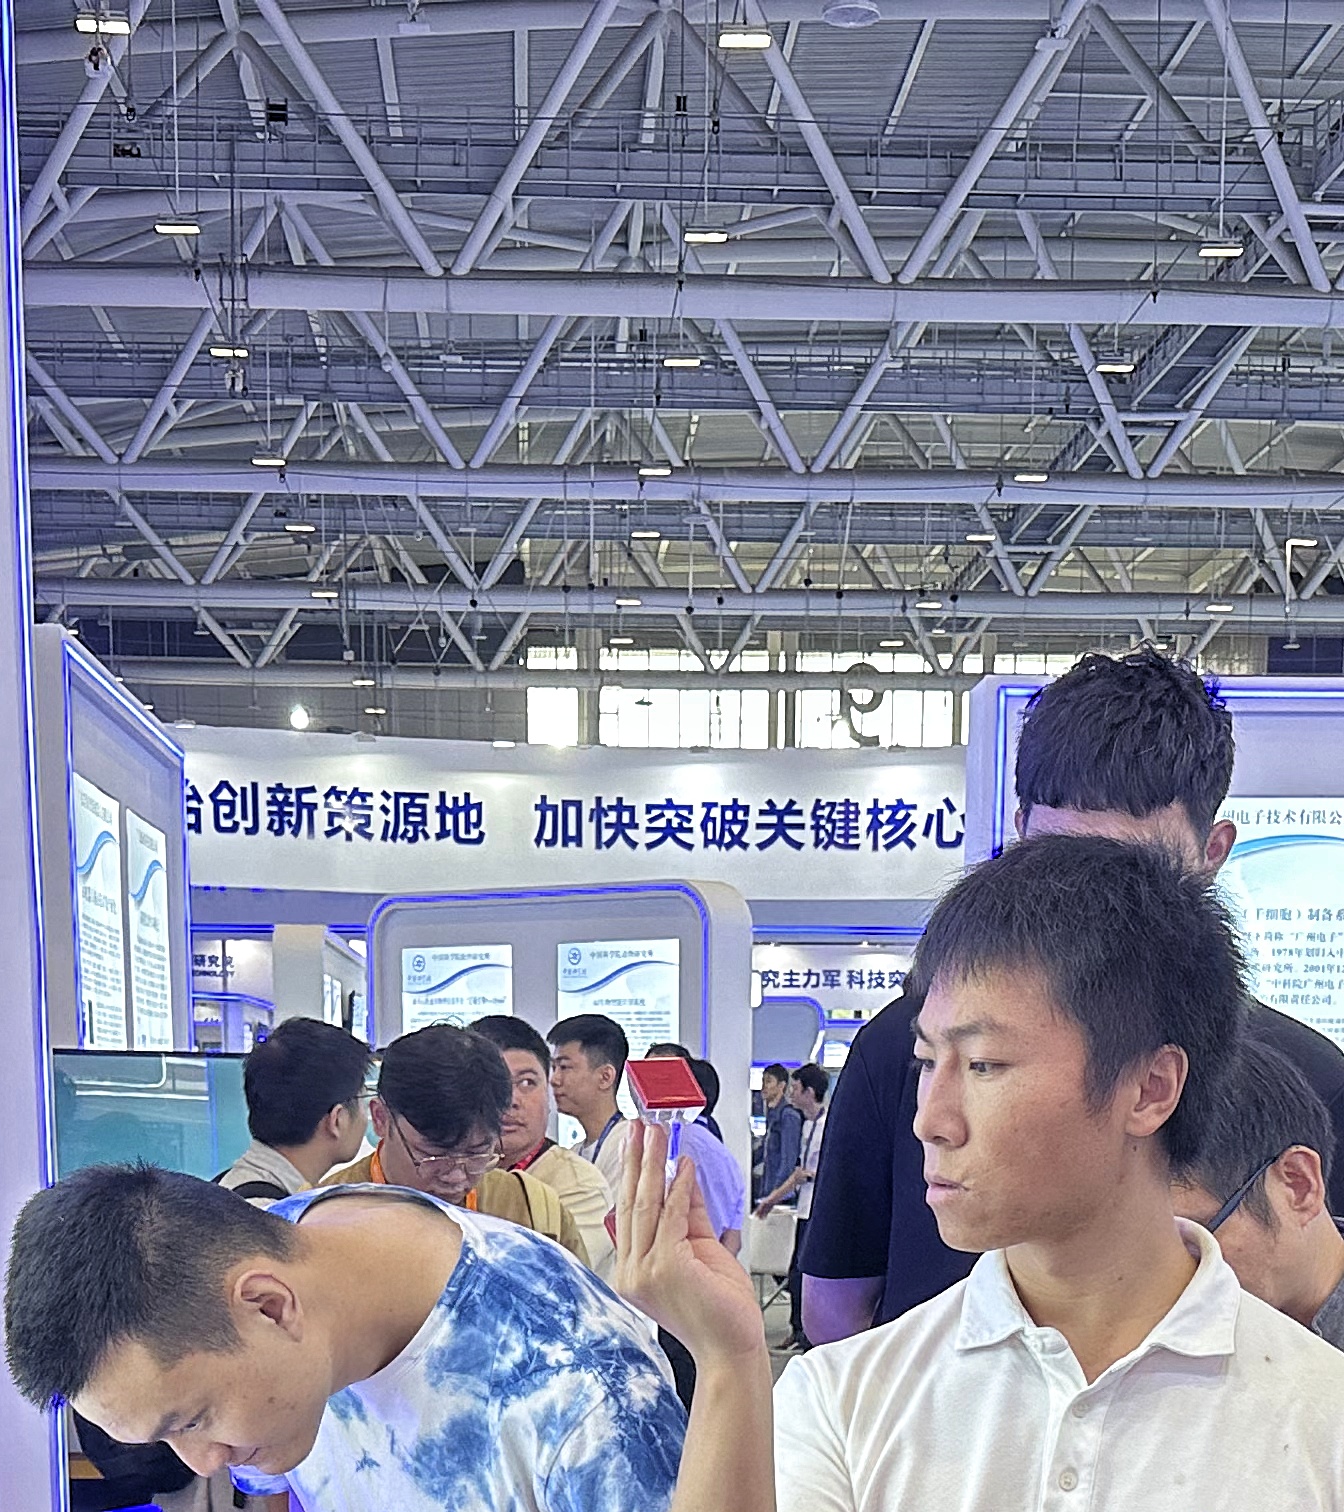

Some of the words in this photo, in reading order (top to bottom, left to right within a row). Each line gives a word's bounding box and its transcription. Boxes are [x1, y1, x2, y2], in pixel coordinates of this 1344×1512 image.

[535, 795, 966, 853] 加快突破关键核心
